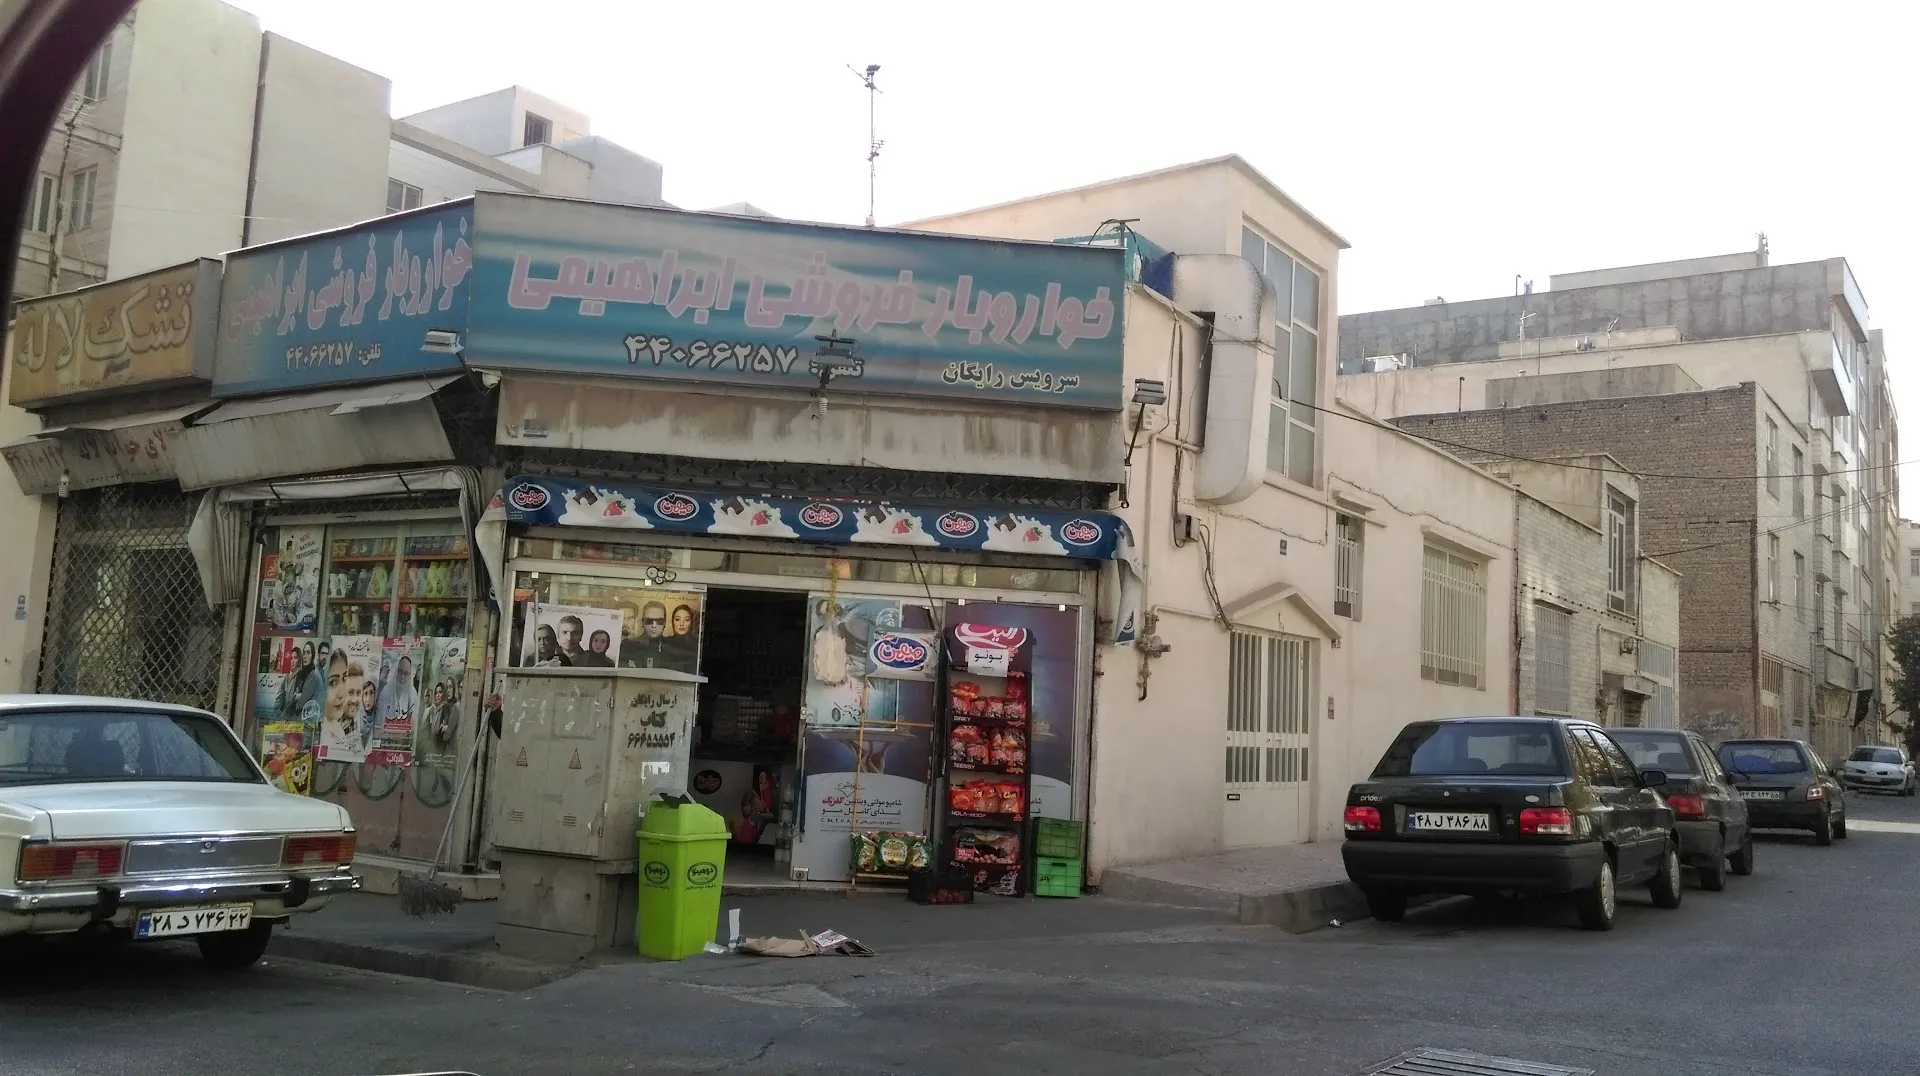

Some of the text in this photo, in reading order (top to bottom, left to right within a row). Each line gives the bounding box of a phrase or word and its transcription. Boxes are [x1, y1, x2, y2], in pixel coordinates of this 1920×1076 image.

[308, 232, 377, 330] فروشی
[508, 250, 737, 325] ابراهیمی
[744, 253, 916, 334] فروشی
[625, 333, 799, 375] ۴۴۰۶۶۲۵۷
[942, 360, 1080, 393] سرویس رایگان
[877, 642, 925, 663] میهن
[974, 651, 1003, 664] بونو
[640, 710, 668, 732] کتاب
[1360, 794, 1378, 803] pride
[1416, 814, 1488, 830] ۴۸ ل ۳۸۶ ۸۸
[691, 867, 714, 877] دومینو
[152, 911, 248, 933] ۲۸ د ۷۳۶ ۲۲
